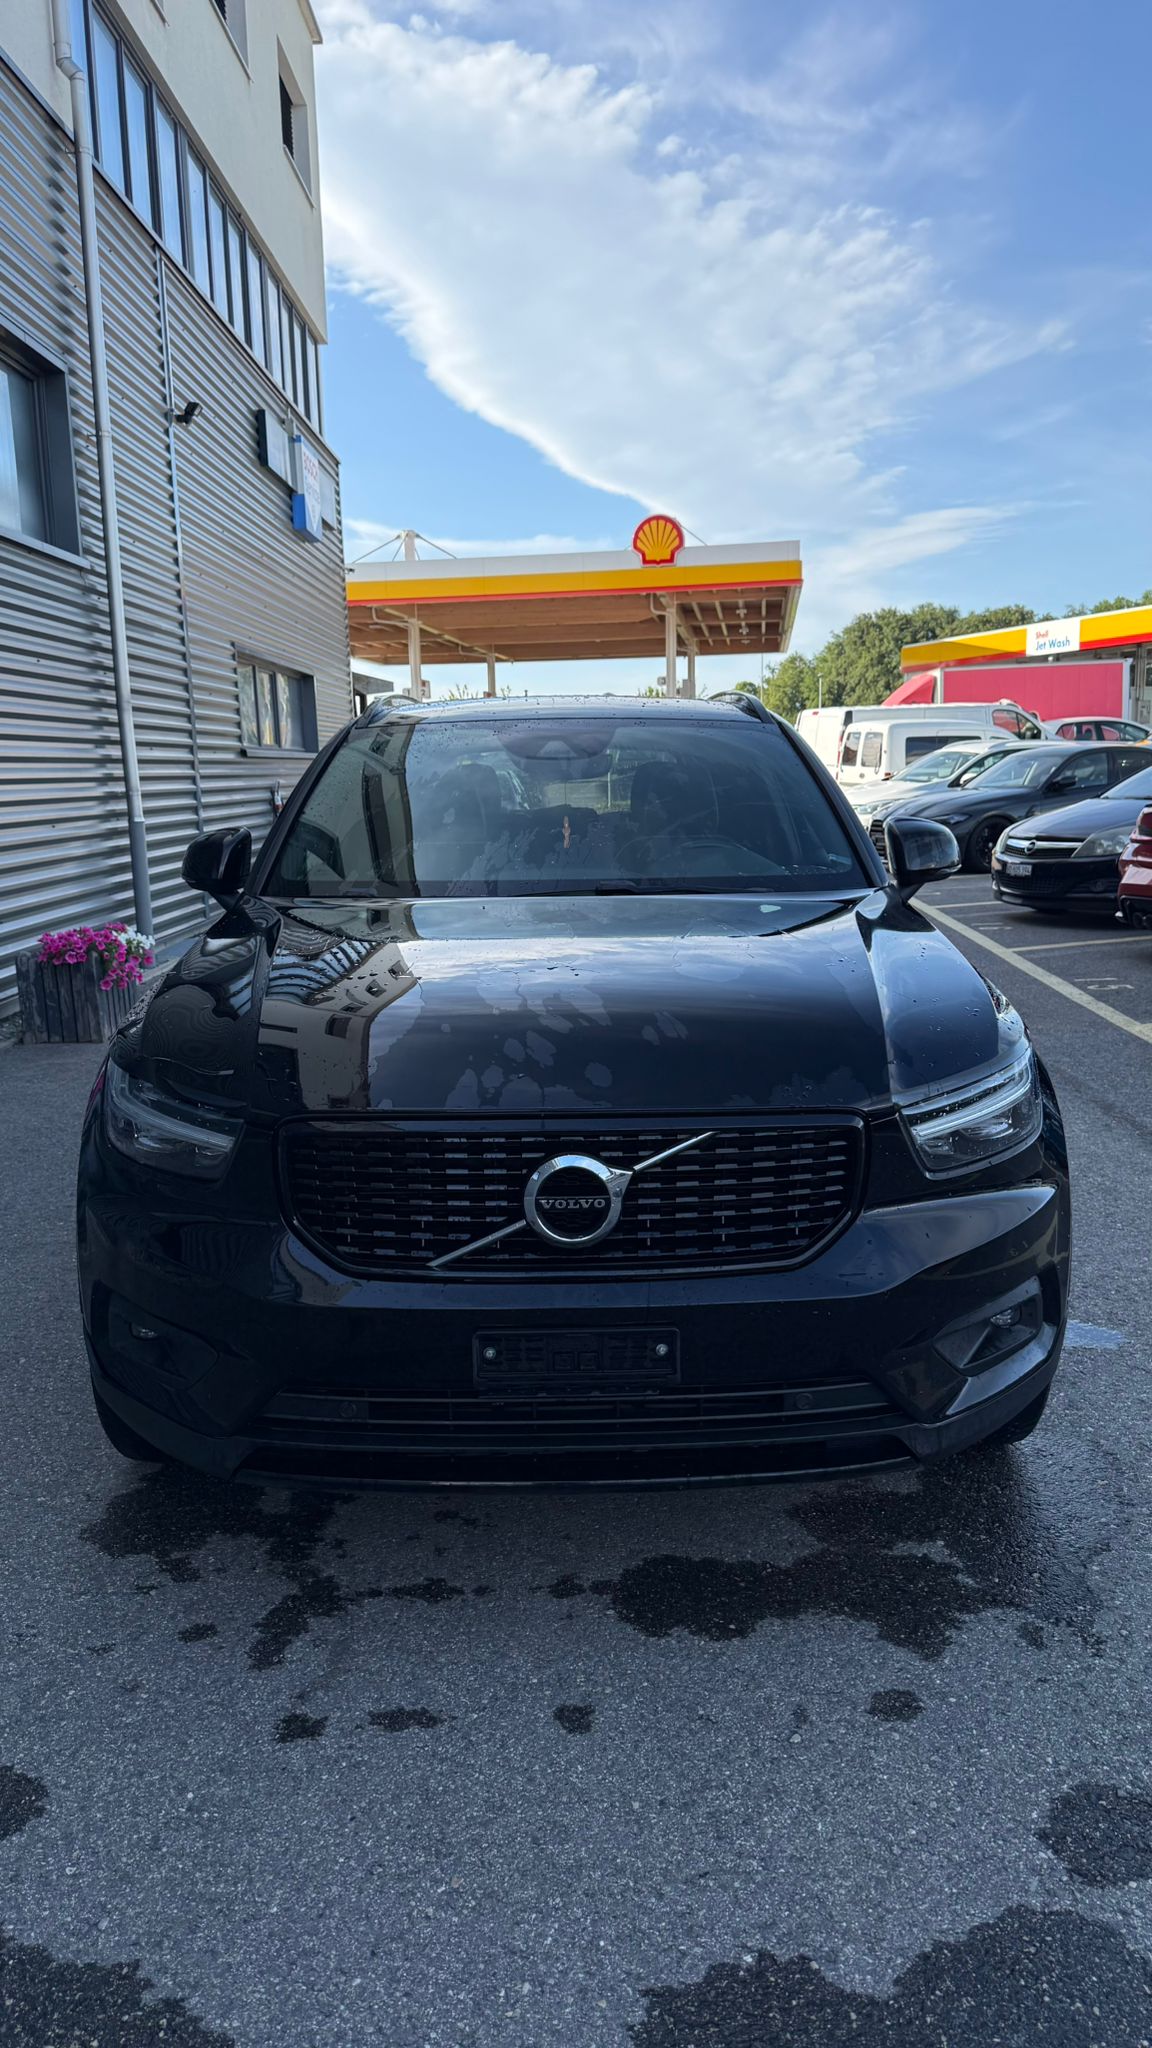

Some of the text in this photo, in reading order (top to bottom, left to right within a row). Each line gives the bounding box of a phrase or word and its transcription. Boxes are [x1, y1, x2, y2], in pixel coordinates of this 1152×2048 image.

[1036, 636, 1070, 651] Jet Wash
[539, 1199, 606, 1209] VOLVO
